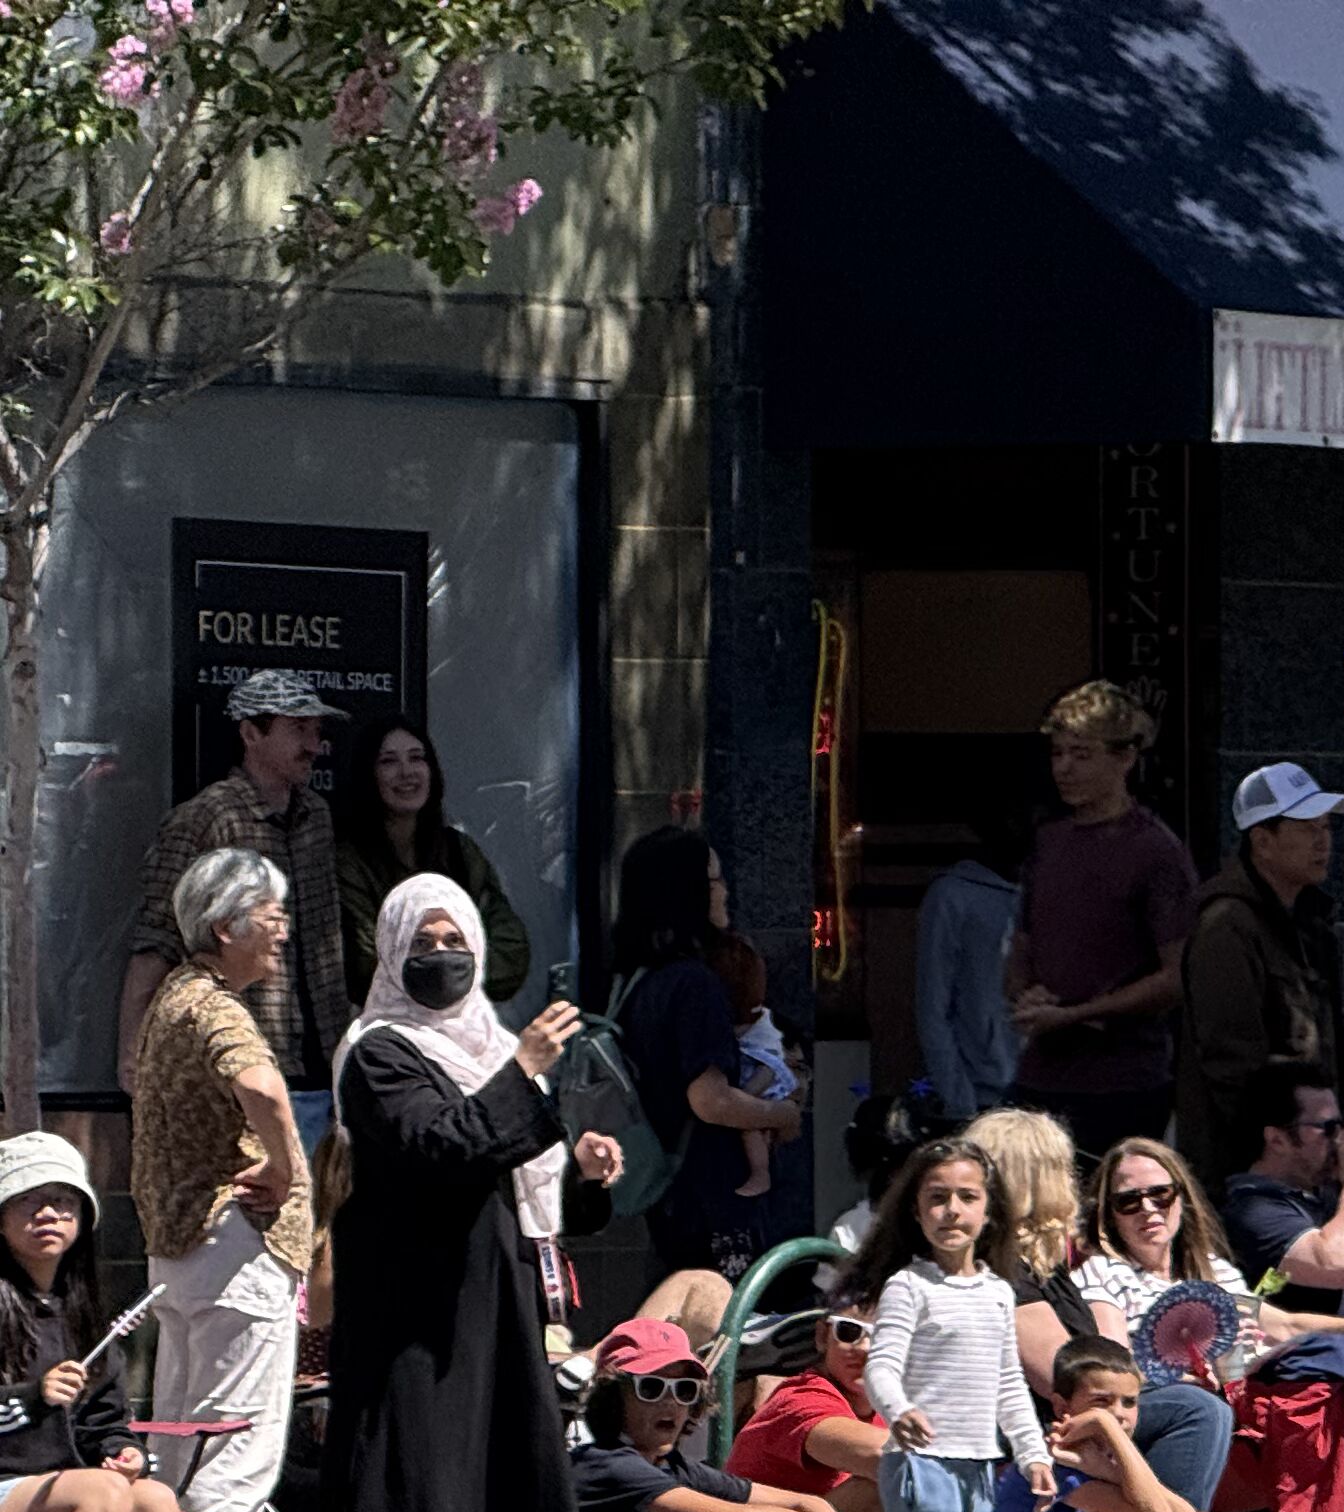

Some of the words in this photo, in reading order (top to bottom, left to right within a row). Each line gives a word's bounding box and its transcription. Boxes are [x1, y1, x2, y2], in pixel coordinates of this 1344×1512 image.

[199, 610, 254, 645] FOR
[261, 613, 342, 649] LEASE
[347, 672, 394, 692] SPACE
